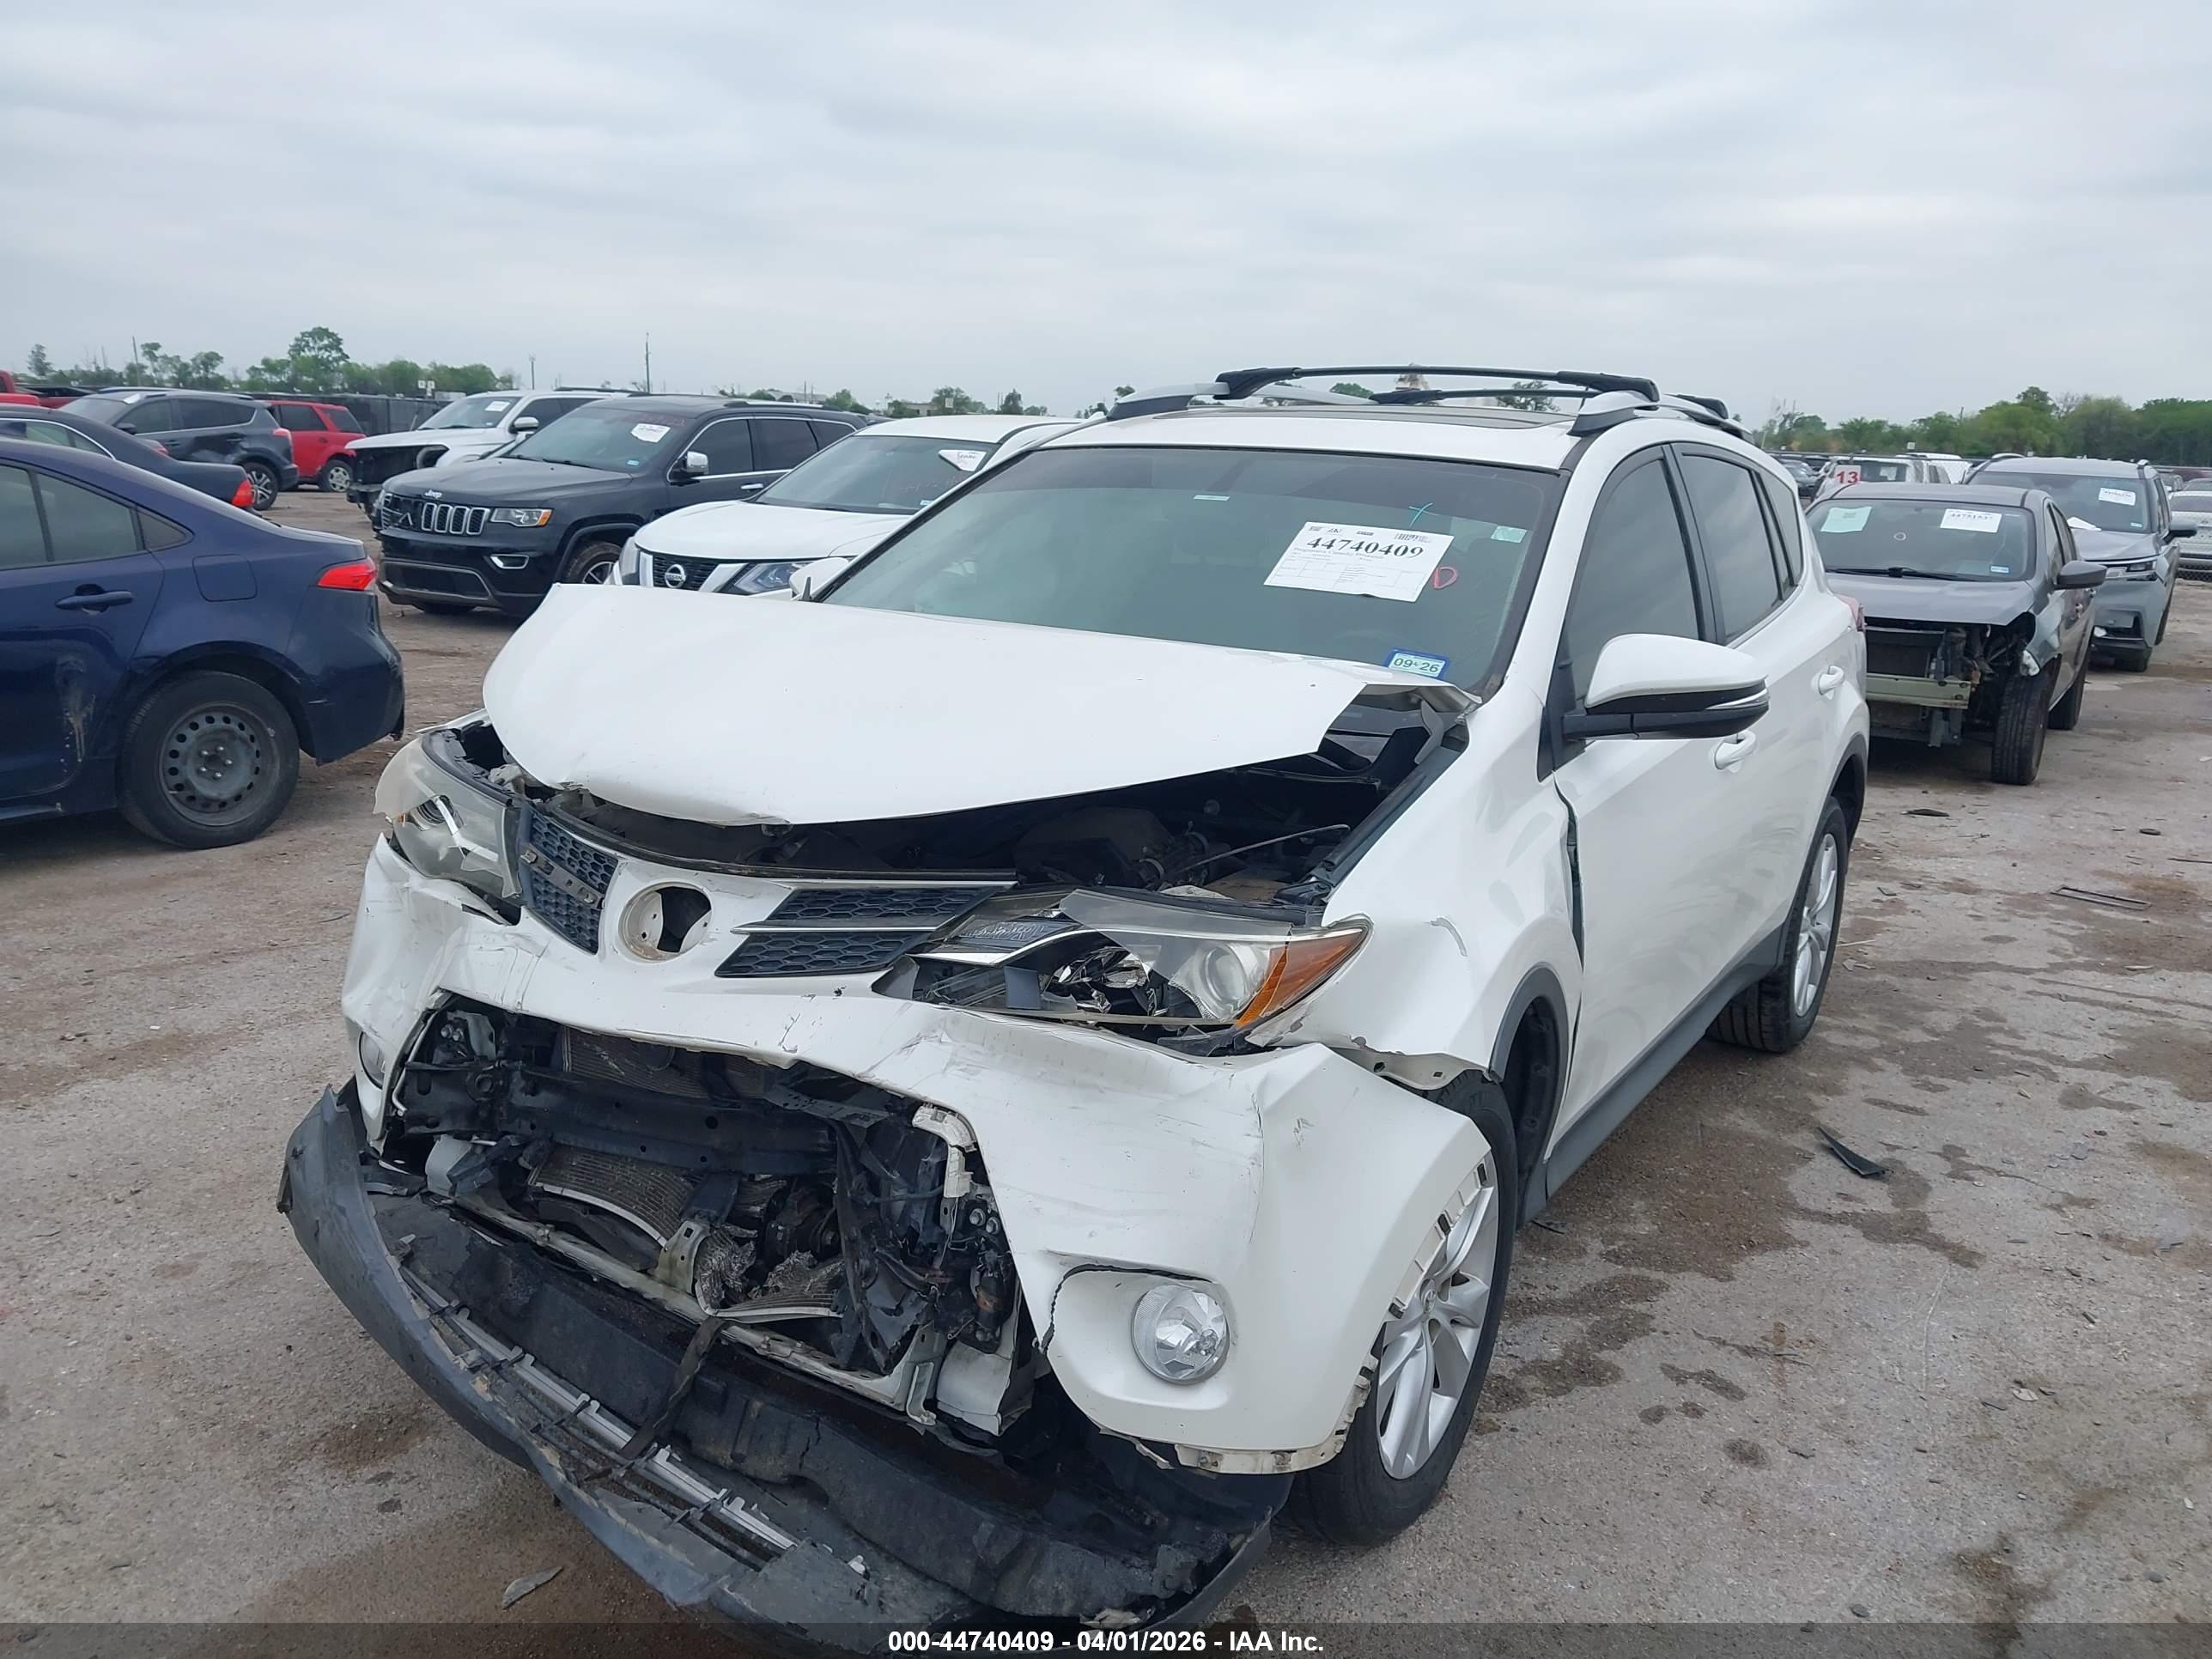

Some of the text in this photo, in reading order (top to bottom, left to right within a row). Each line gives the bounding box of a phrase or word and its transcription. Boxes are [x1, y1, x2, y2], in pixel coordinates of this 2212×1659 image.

[1836, 471, 1859, 484] 13
[1306, 537, 1425, 559] 44740409
[1394, 658, 1440, 673] 09 26
